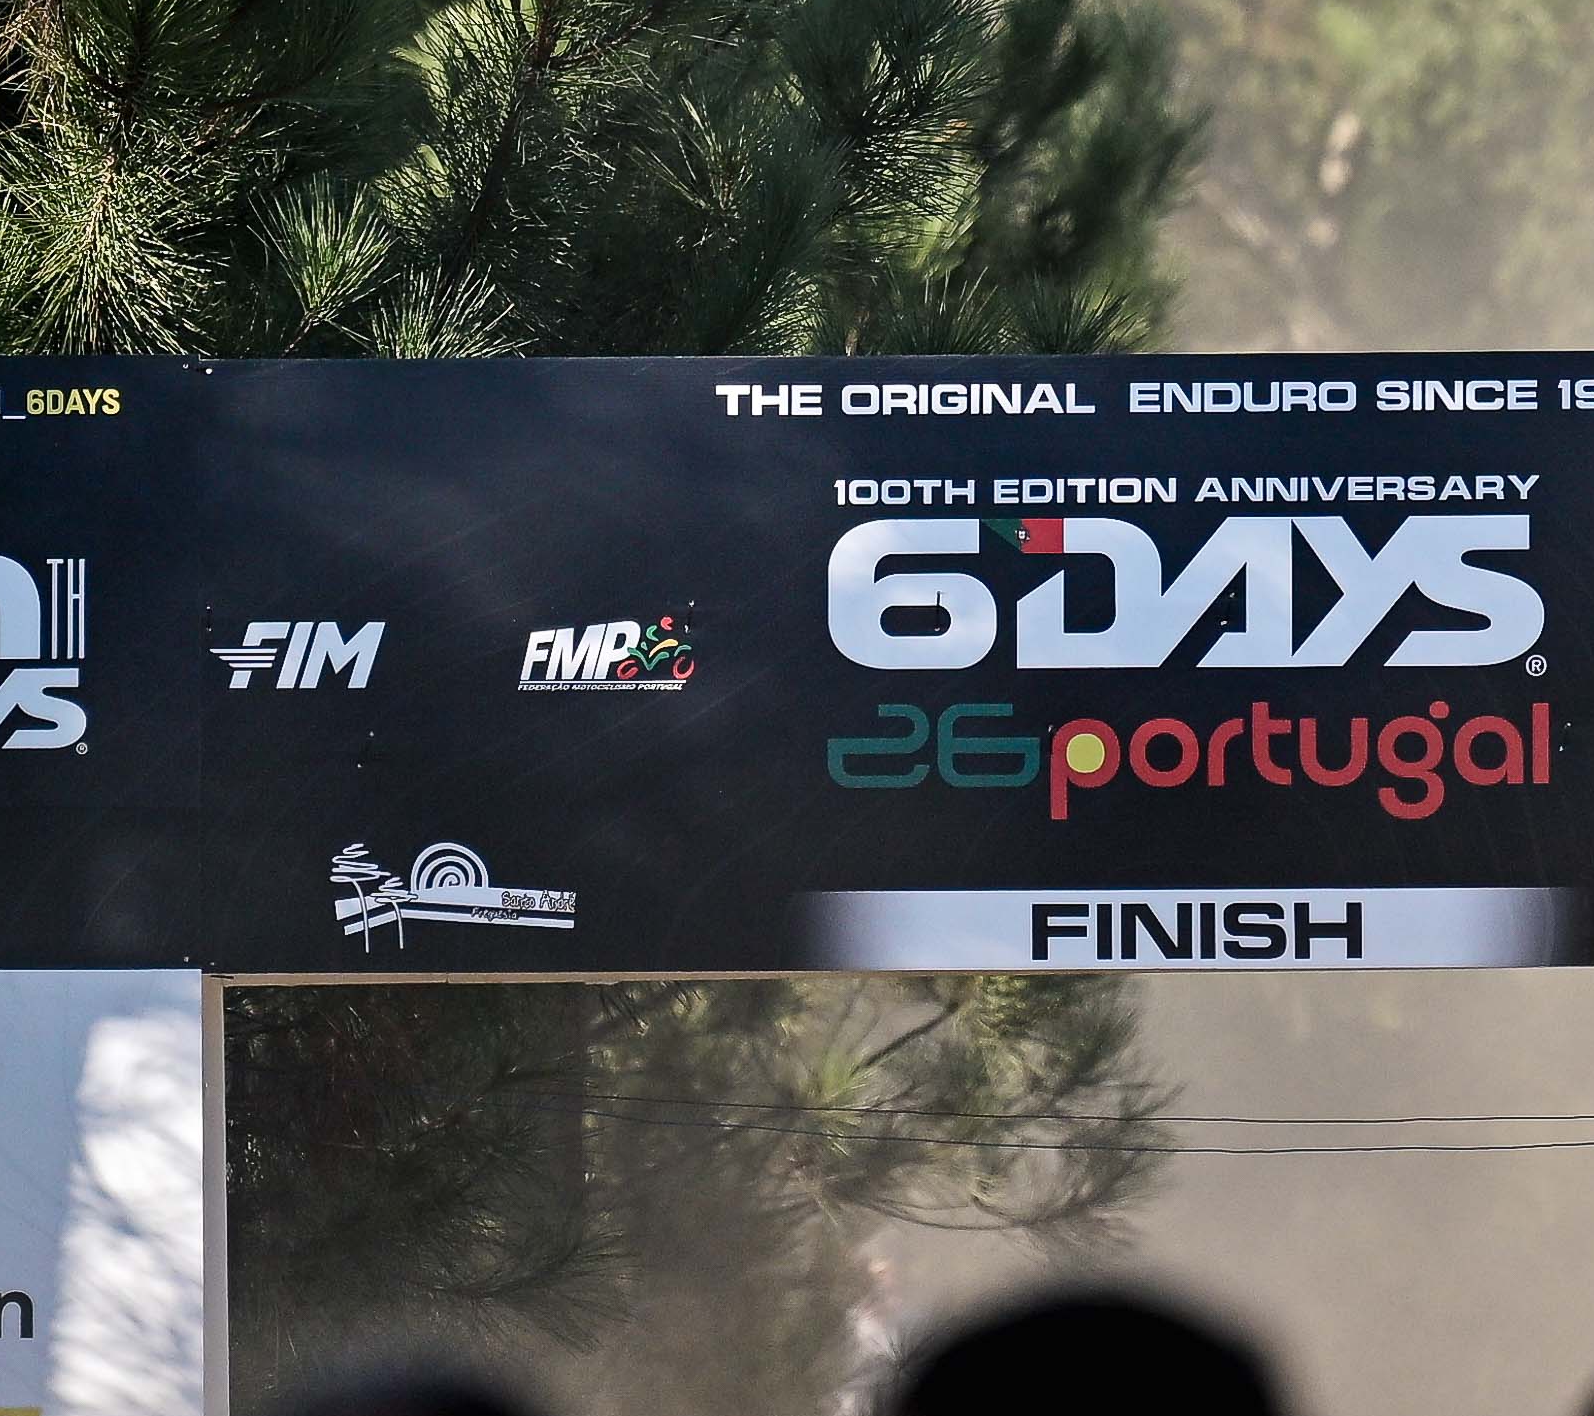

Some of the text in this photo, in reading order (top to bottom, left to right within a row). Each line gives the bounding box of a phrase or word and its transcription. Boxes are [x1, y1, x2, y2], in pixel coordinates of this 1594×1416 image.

[715, 384, 823, 416] THE
[841, 383, 1096, 416] ORIGINAL
[1129, 381, 1357, 413] ENDURO
[1376, 380, 1538, 412] SINCE
[833, 474, 1540, 506] 100TH EDITION ANNIVERSARY
[209, 621, 386, 689] FIM
[520, 620, 642, 681] FMP
[637, 683, 683, 691] PORTUGAL
[1030, 901, 1364, 962] FINISH
